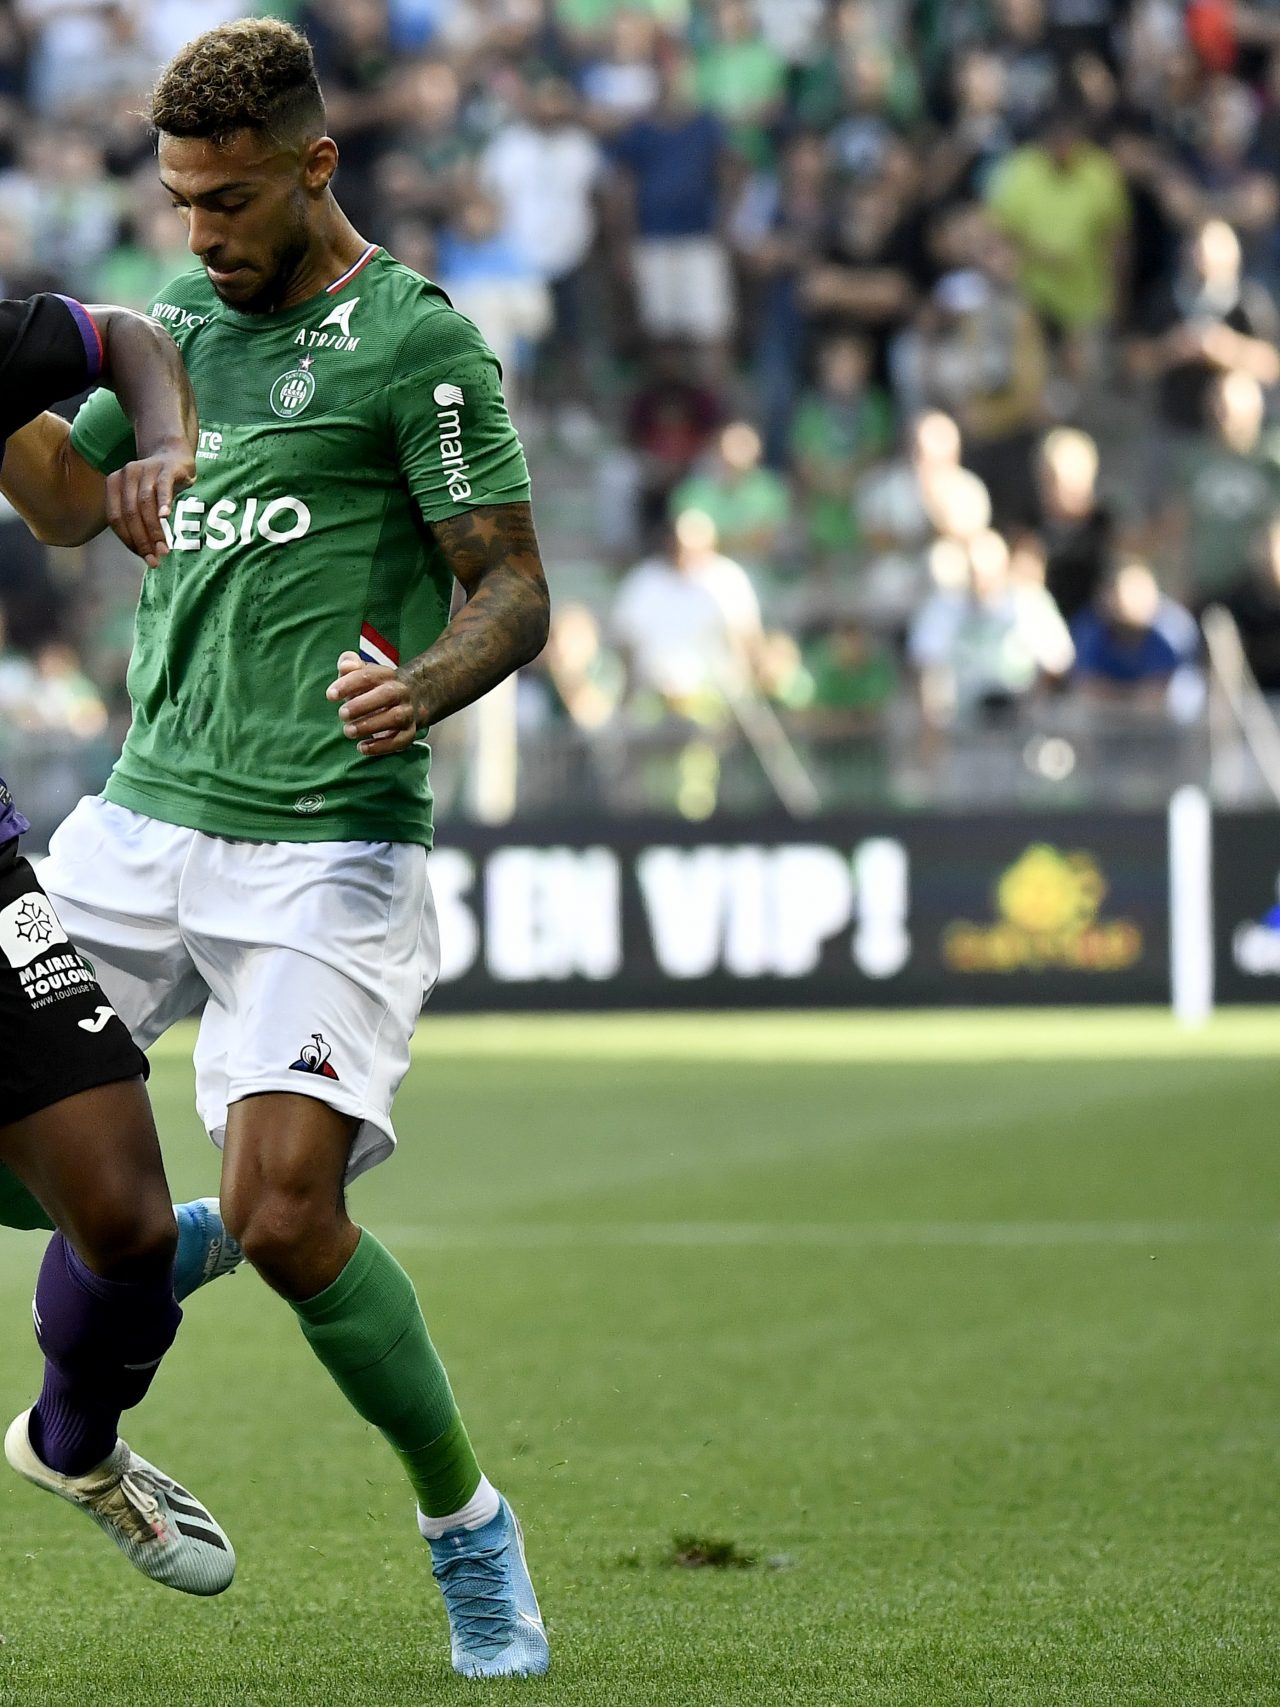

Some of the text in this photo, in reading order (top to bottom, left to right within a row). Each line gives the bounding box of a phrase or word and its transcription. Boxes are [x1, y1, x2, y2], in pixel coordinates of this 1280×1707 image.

[293, 328, 361, 352] ATRIUM
[637, 838, 910, 978] VIP!
[18, 954, 76, 985] MAIRIE
